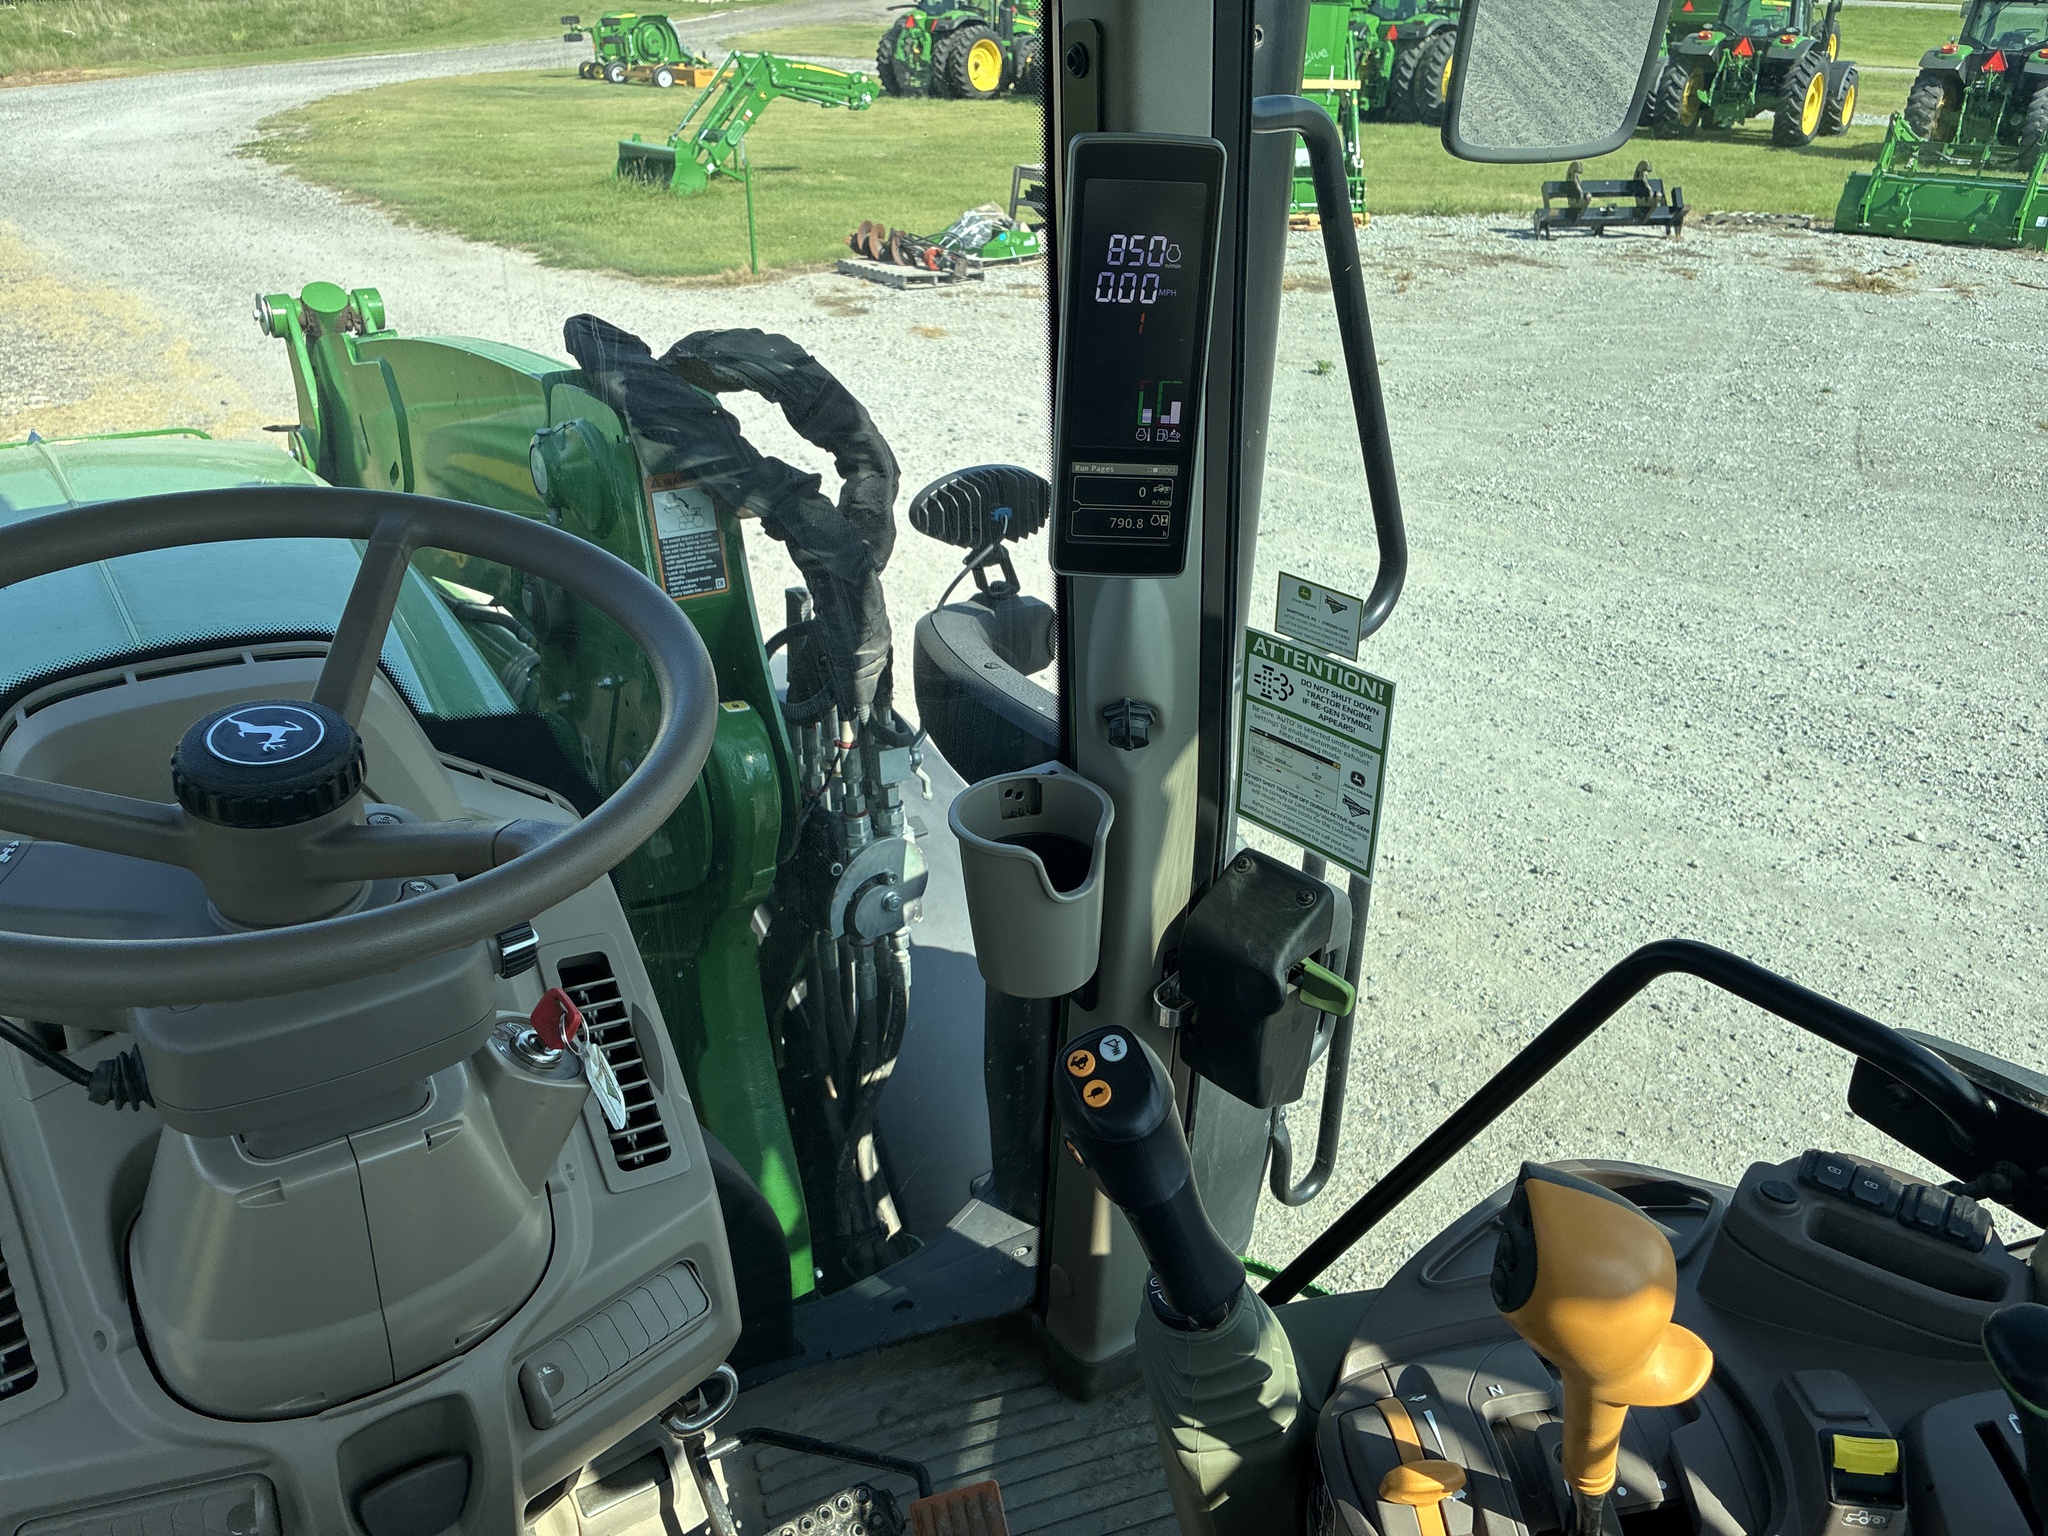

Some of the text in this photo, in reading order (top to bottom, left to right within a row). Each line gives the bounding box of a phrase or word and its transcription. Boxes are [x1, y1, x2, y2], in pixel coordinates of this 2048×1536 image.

[1107, 234, 1167, 267] 850
[1095, 271, 1160, 304] 0.00
[1158, 289, 1177, 297] MPH
[1075, 464, 1115, 474] Run Pages
[1138, 486, 1147, 498] 0
[1109, 517, 1144, 529] 790.8
[1302, 601, 1316, 609] DEERE
[1252, 634, 1384, 701] ATTENTION!
[1300, 677, 1379, 715] DO NOT SHUT DOWN
[1305, 689, 1372, 722] TRACTOR ENGINE
[1302, 697, 1373, 732] IF RE-GEN SYMBOL
[1318, 712, 1355, 734] APPEARS!
[1252, 703, 1373, 761] Be sure 'AUTO' is selected under engine
[1254, 711, 1370, 767] settings to enable automatic exhaust
[1278, 729, 1341, 761] filter cleaning mode.
[1356, 787, 1372, 799] DEERE
[1485, 1384, 1505, 1397] N
